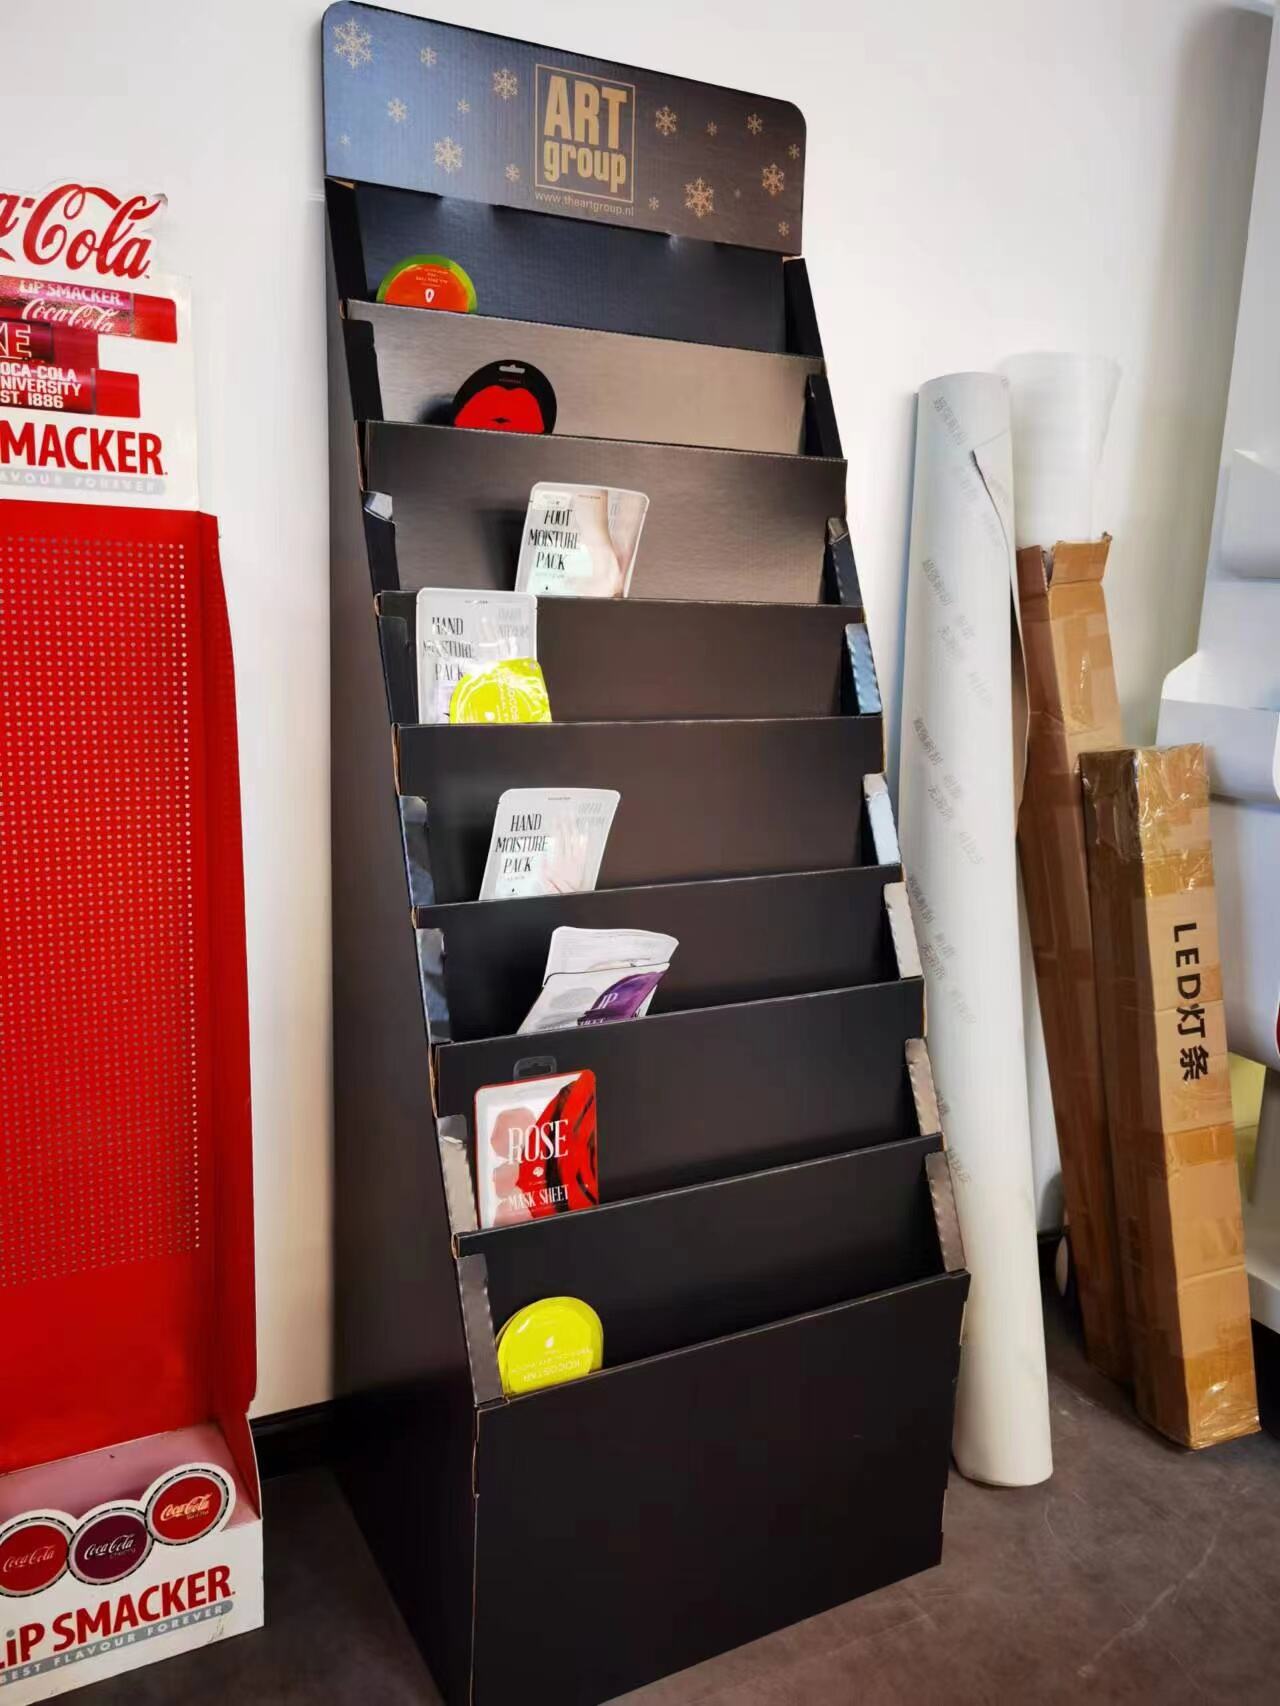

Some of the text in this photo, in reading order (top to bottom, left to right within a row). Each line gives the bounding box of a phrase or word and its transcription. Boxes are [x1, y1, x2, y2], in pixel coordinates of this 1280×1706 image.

[544, 75, 628, 149] ART
[543, 140, 627, 193] group
[535, 191, 634, 217] www.theartgroup.nl
[47, 286, 124, 306] SMACKER
[0, 375, 82, 397] NIVERSITY
[27, 393, 64, 409] 1886
[0, 420, 164, 476] MACKER
[543, 509, 573, 527] FOOT
[536, 551, 566, 571] PACK
[432, 616, 464, 636] HAND
[510, 813, 542, 832] HAND
[503, 857, 532, 874] PACK
[508, 1119, 570, 1165] ROSE
[508, 1184, 570, 1210] MASK SHEET
[0, 1564, 232, 1670] iP SMACKER
[53, 1634, 137, 1668] FLAVOUR
[147, 1604, 225, 1636] FOREVER
